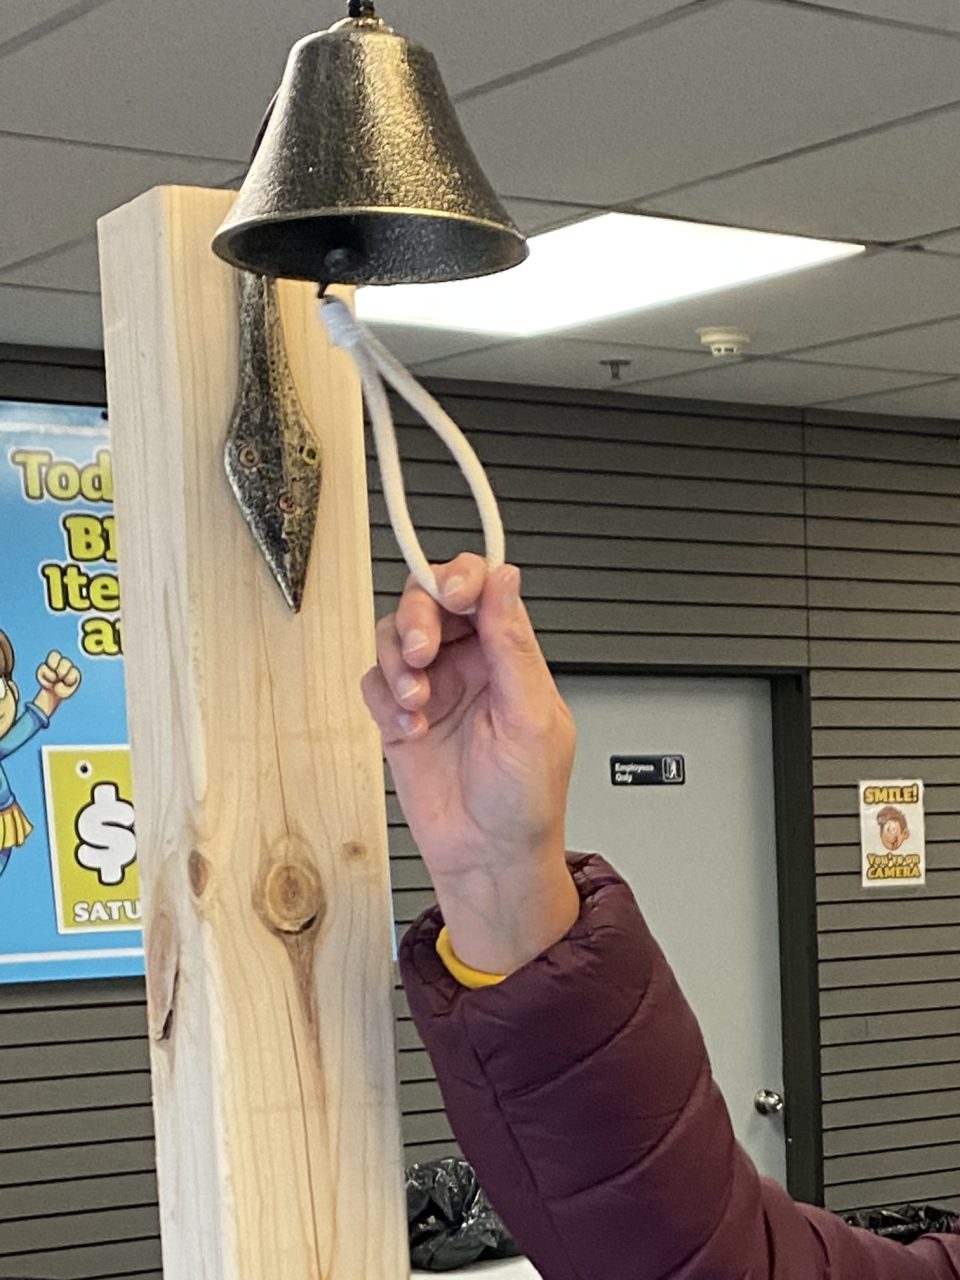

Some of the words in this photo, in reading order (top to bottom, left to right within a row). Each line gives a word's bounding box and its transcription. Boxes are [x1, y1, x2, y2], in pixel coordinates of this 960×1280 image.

[81, 616, 124, 656] a
[864, 783, 919, 804] SMILE!
[866, 865, 921, 880] CAMERA
